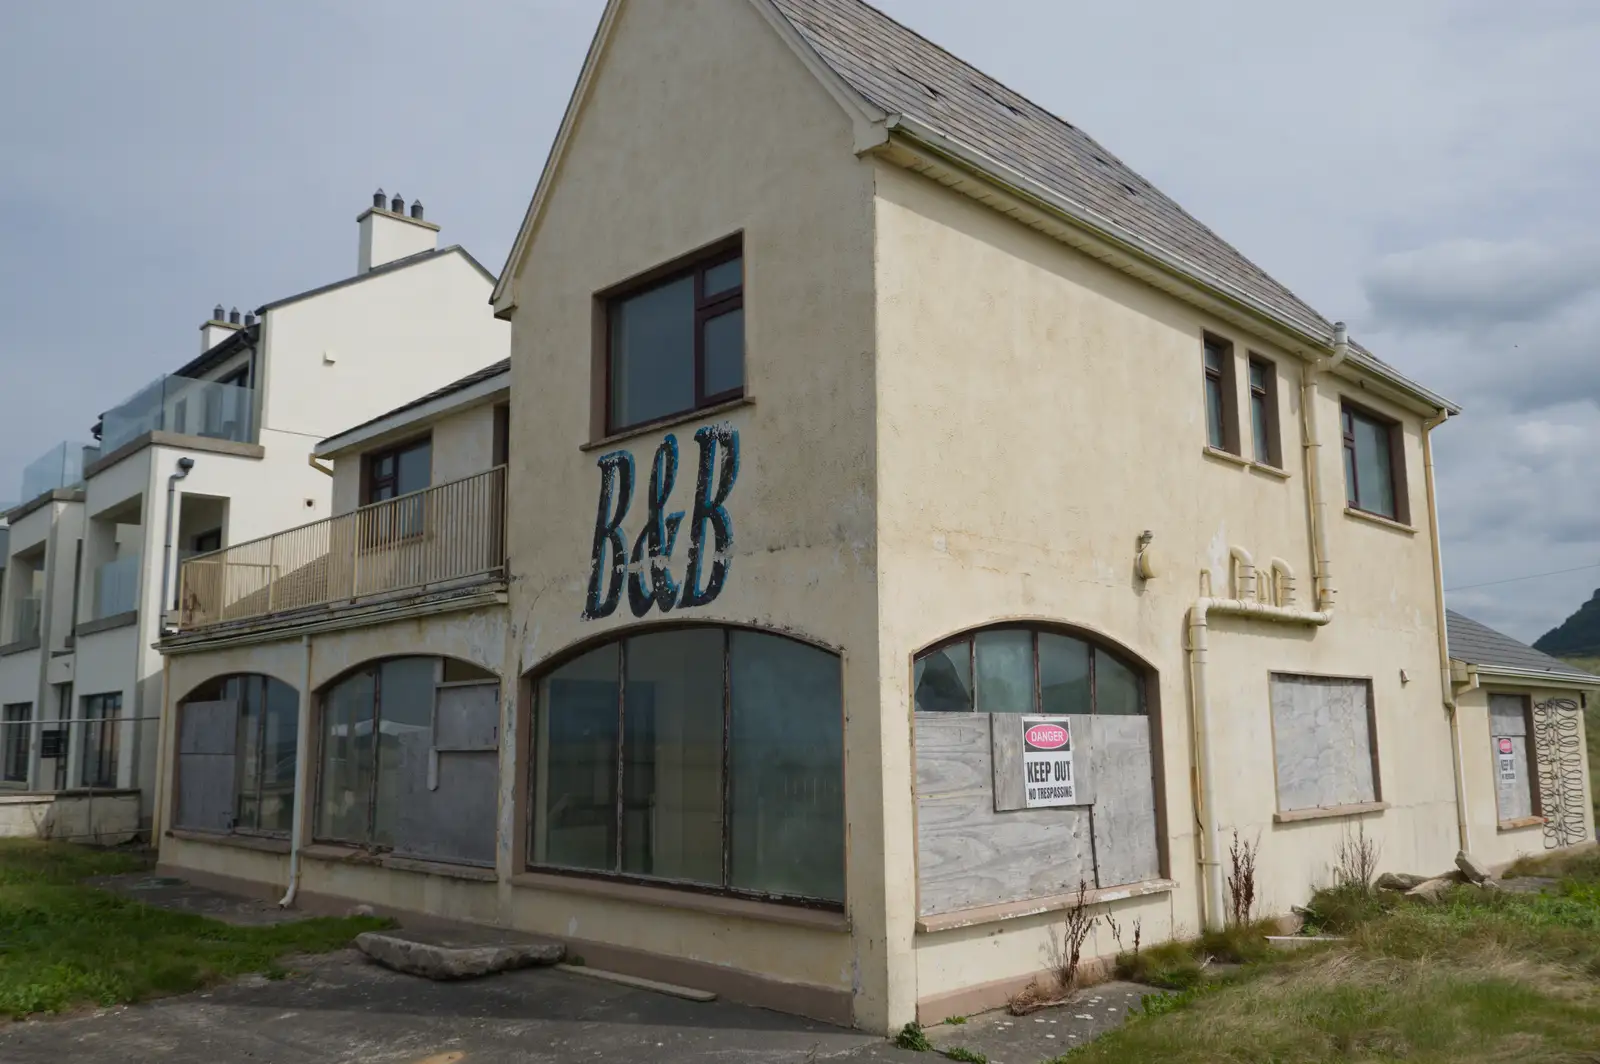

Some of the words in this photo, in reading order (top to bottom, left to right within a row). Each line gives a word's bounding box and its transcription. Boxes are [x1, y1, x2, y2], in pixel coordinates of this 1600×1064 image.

[580, 421, 740, 622] B&B
[1031, 731, 1064, 742] DANGER
[1027, 761, 1051, 783] KEEP
[1054, 761, 1071, 782] OUT
[1028, 788, 1037, 800] NO
[1037, 786, 1072, 799] TRESPASSING
